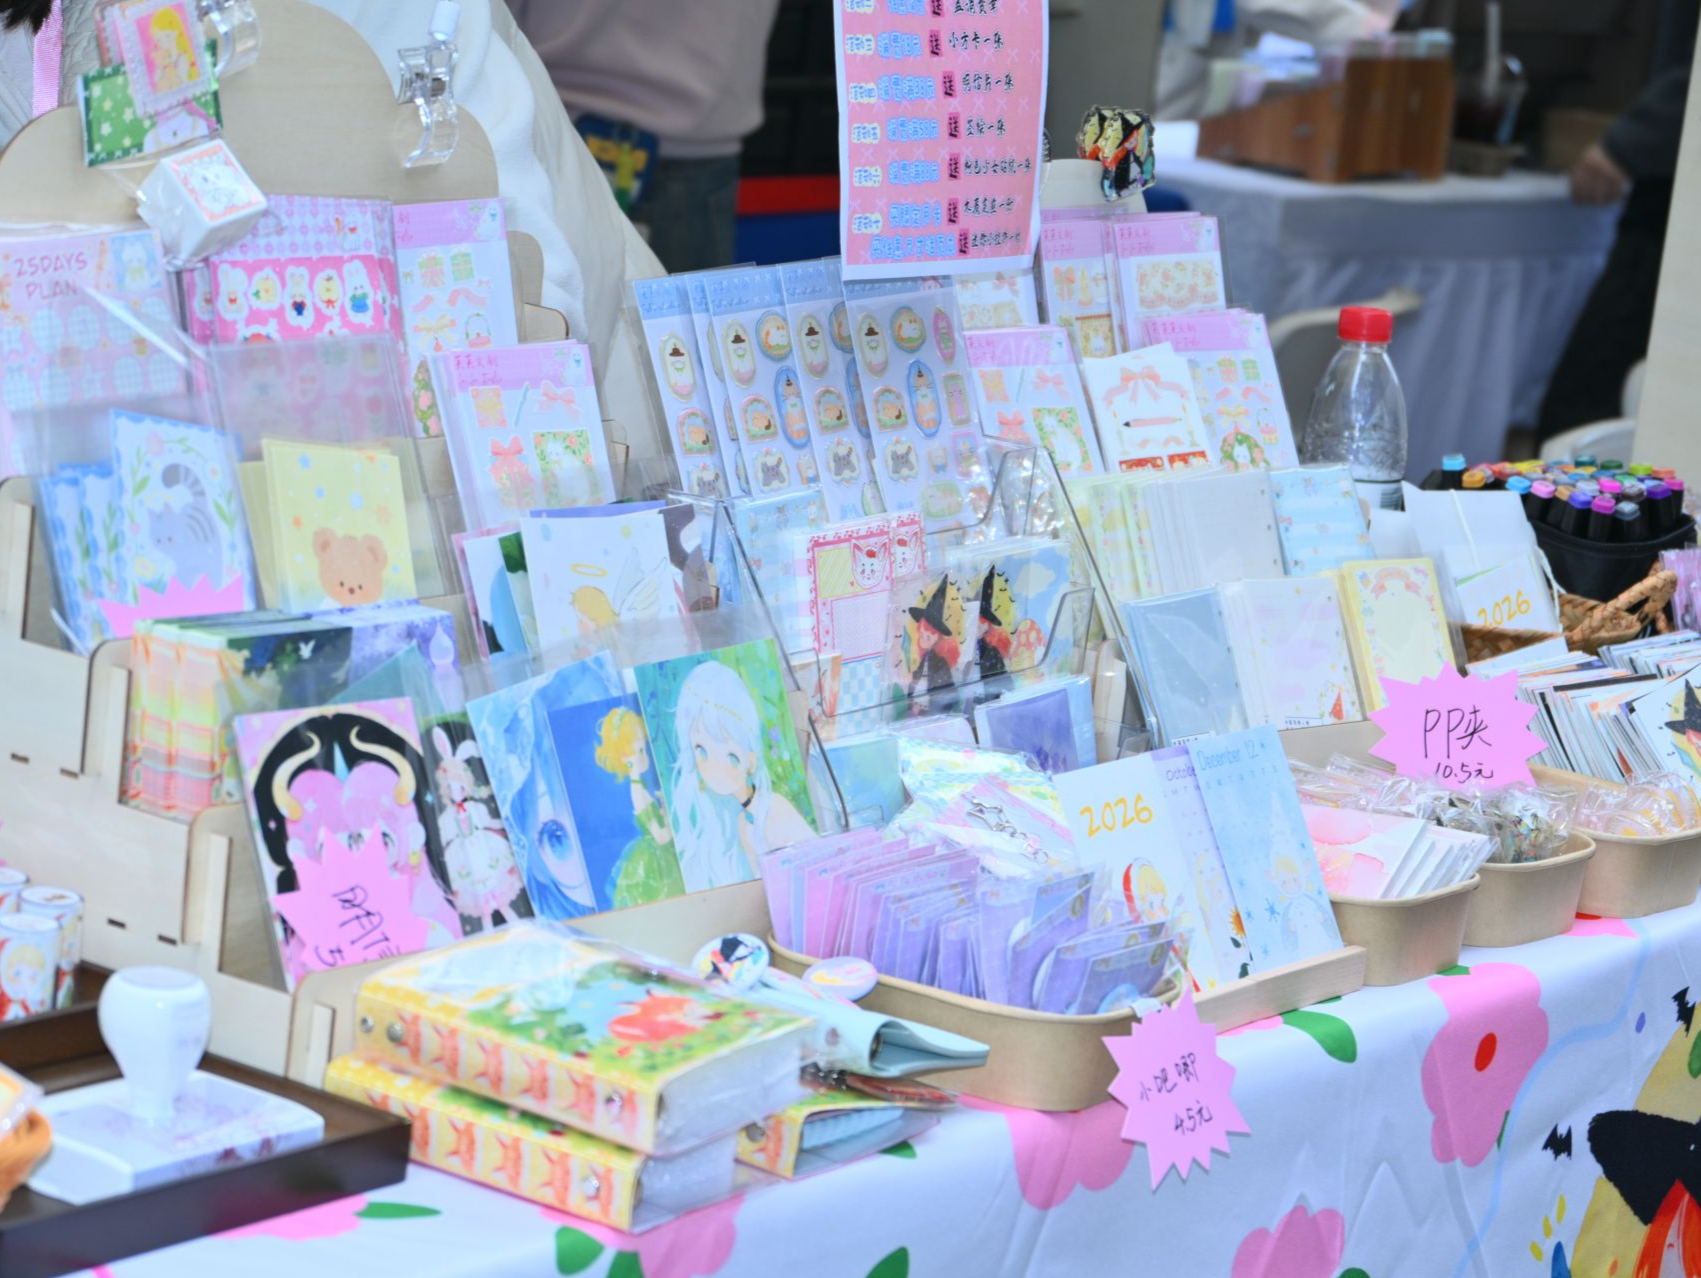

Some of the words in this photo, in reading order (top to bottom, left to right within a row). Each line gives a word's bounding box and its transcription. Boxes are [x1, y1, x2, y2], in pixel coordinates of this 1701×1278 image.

[846, 35, 874, 55] 活动三
[929, 33, 941, 56] 送
[850, 84, 877, 103] 活动四
[943, 75, 955, 97] 送
[852, 124, 880, 143] 活动五
[949, 115, 960, 138] 送
[853, 166, 882, 187] 活动六
[949, 157, 960, 179] 送
[853, 214, 882, 233] 活动七
[948, 200, 960, 224] 送
[959, 232, 969, 254] 送
[14, 251, 88, 278] 25DAYS
[25, 279, 78, 300] PLAN
[1477, 590, 1531, 626] 2026
[1423, 704, 1493, 759] PP夹
[1435, 761, 1494, 784] 10.5元
[1080, 792, 1153, 838] 2026
